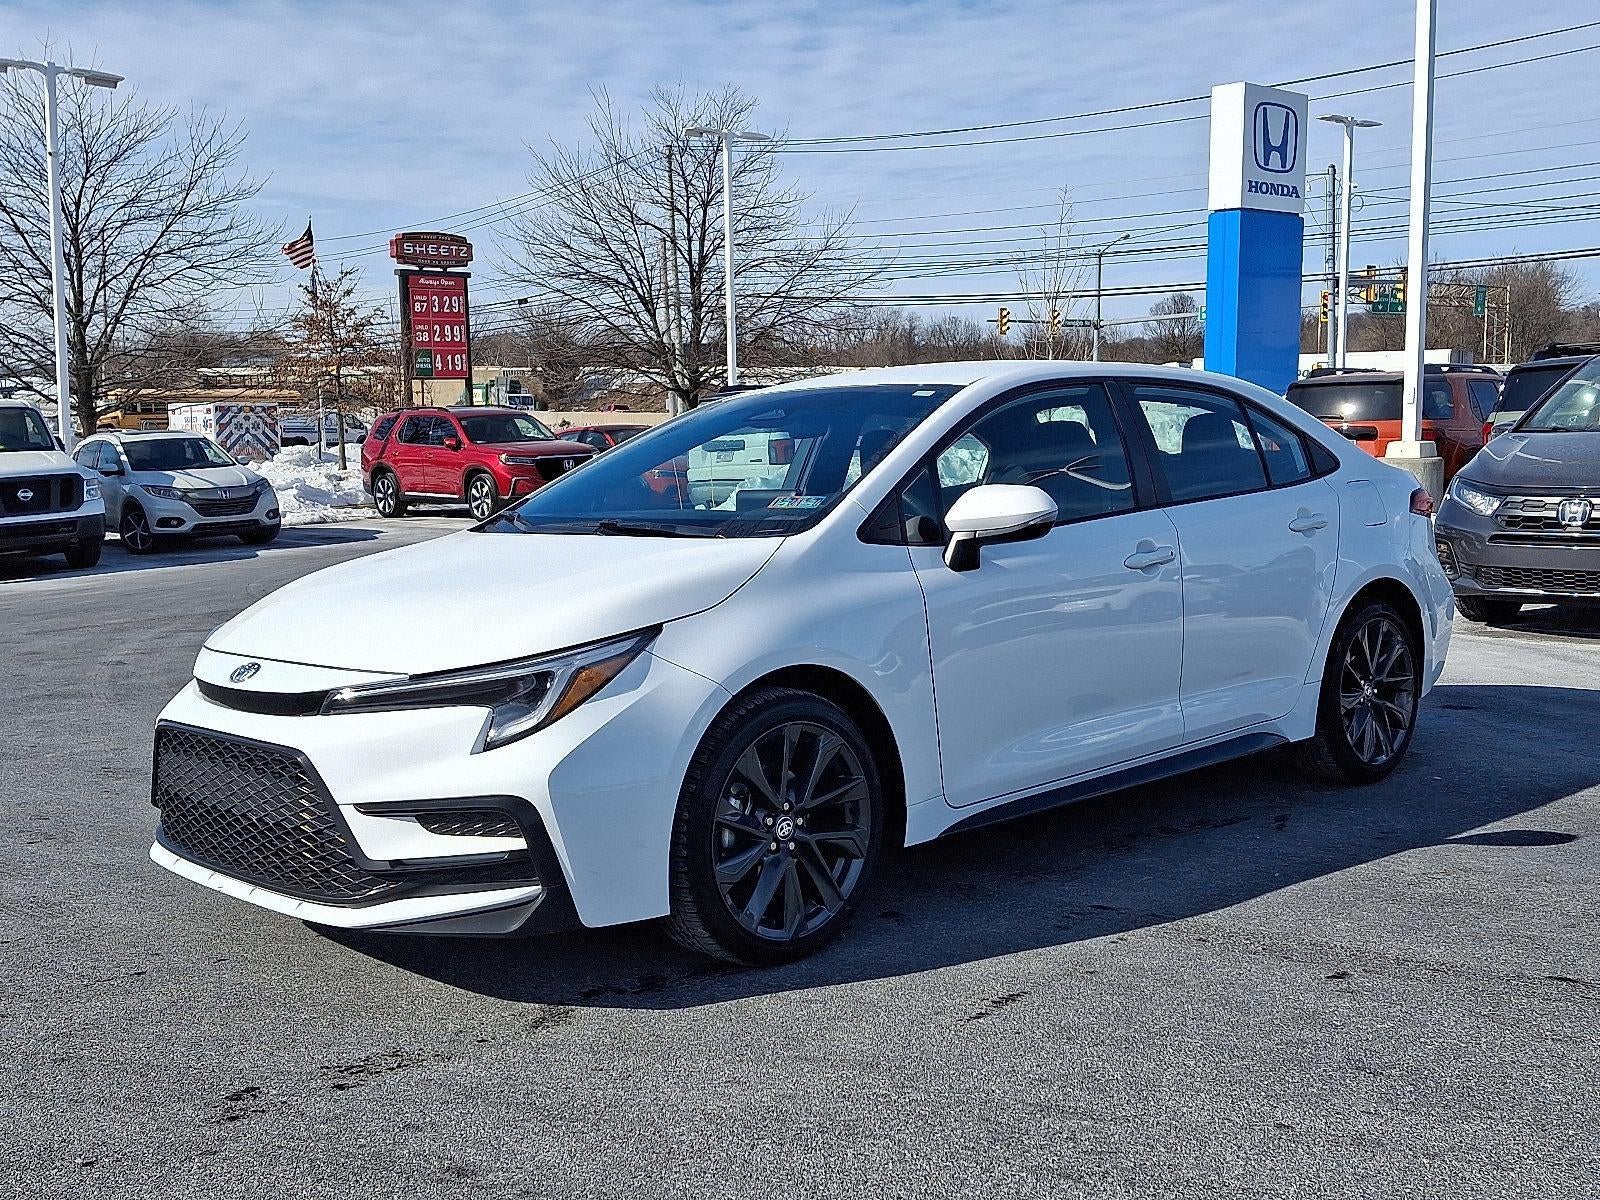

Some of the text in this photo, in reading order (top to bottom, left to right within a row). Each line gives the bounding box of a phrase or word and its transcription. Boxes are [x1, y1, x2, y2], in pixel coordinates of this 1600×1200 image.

[1247, 179, 1301, 199] HONDA
[403, 242, 468, 257] SHEETZ
[419, 277, 456, 286] Always Open
[414, 301, 428, 313] 87
